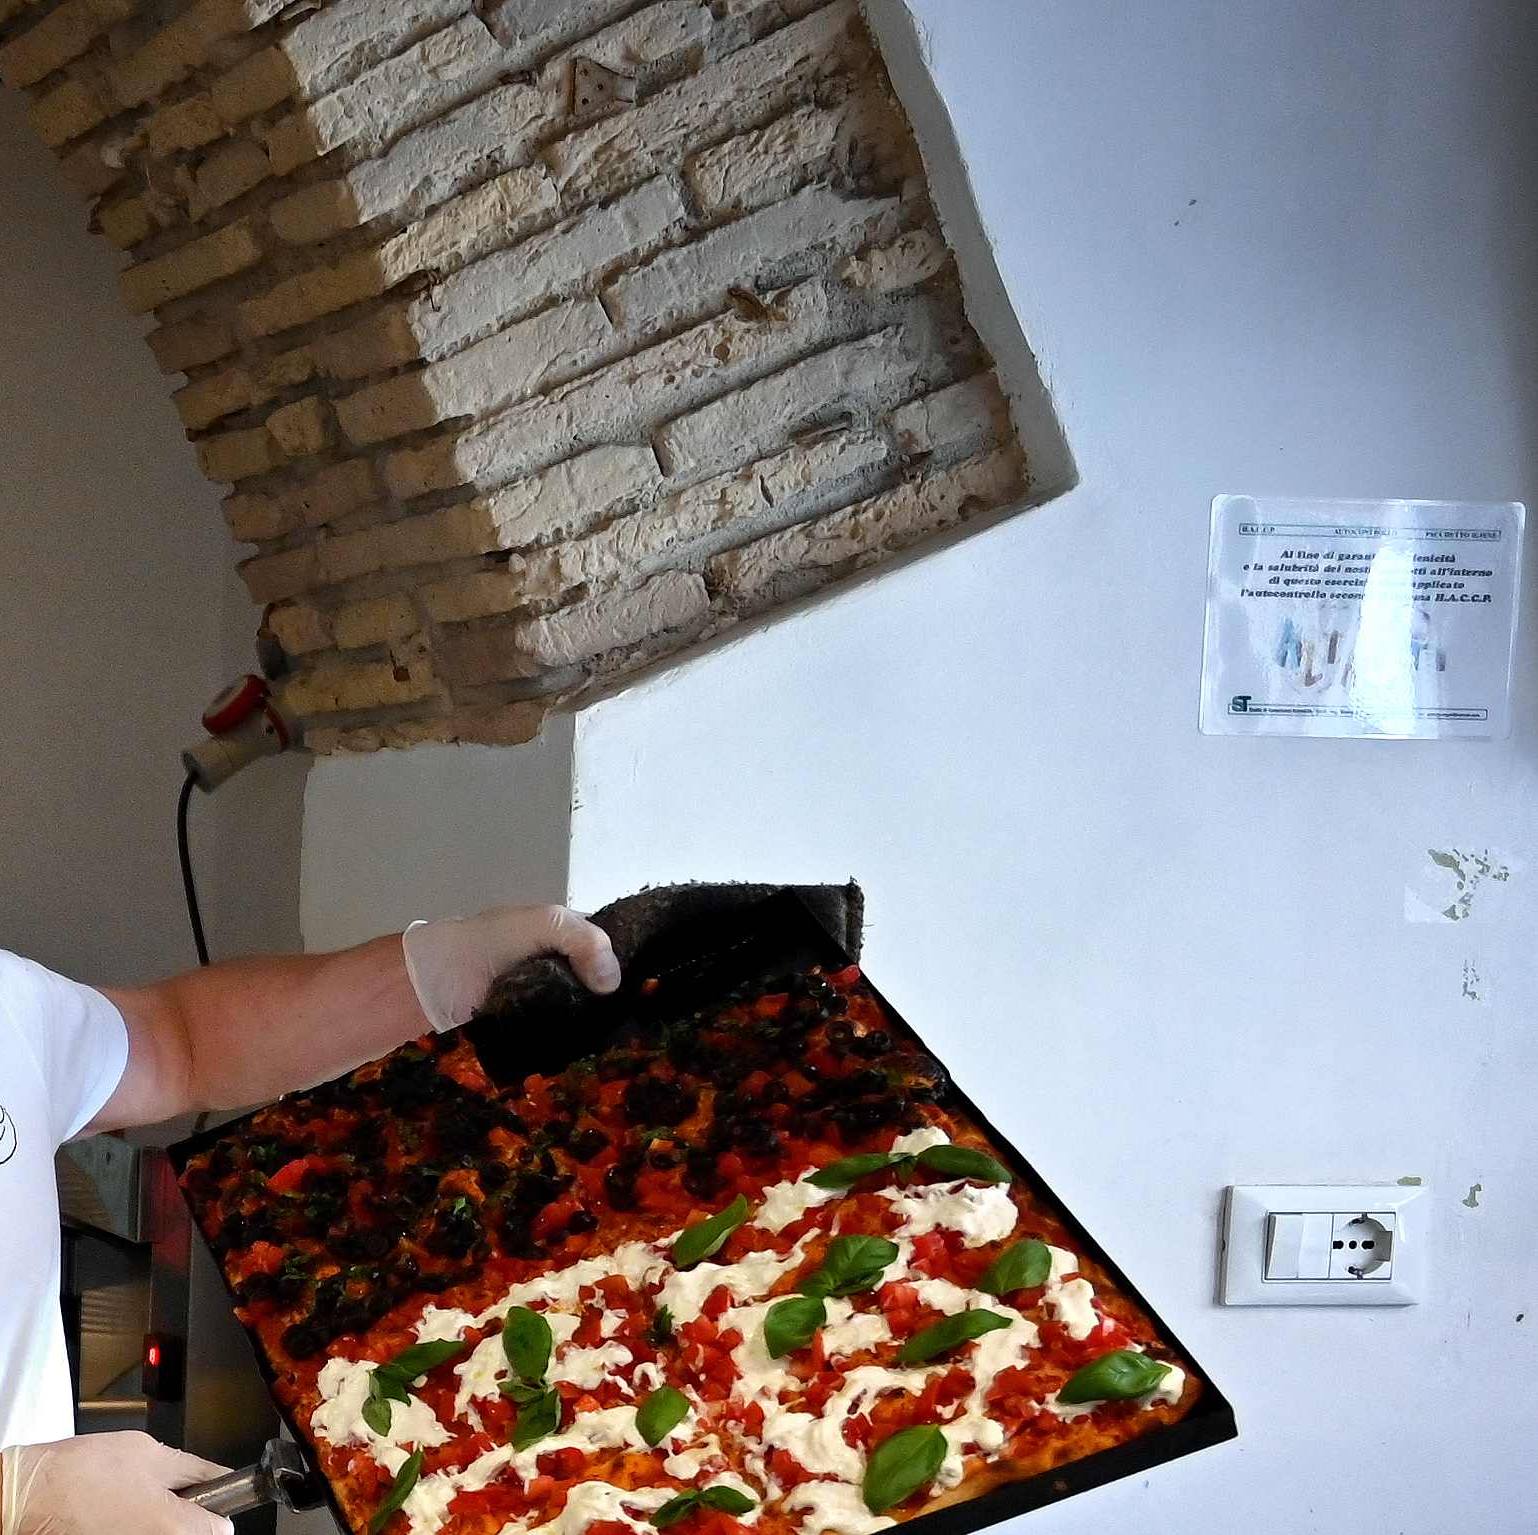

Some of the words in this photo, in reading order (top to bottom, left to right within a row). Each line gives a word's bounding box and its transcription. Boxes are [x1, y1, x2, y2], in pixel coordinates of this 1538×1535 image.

[1280, 550, 1294, 559] Al
[1297, 550, 1320, 560] fine
[1323, 551, 1335, 560] di
[1253, 563, 1264, 571] la
[1267, 563, 1319, 572] salubrità
[1429, 567, 1493, 577] all'interno
[1268, 576, 1281, 585] di
[1283, 577, 1322, 587] questo
[1324, 578, 1367, 587] eserciz
[1240, 588, 1327, 599] l'autocontrollo
[1329, 591, 1365, 600] secon
